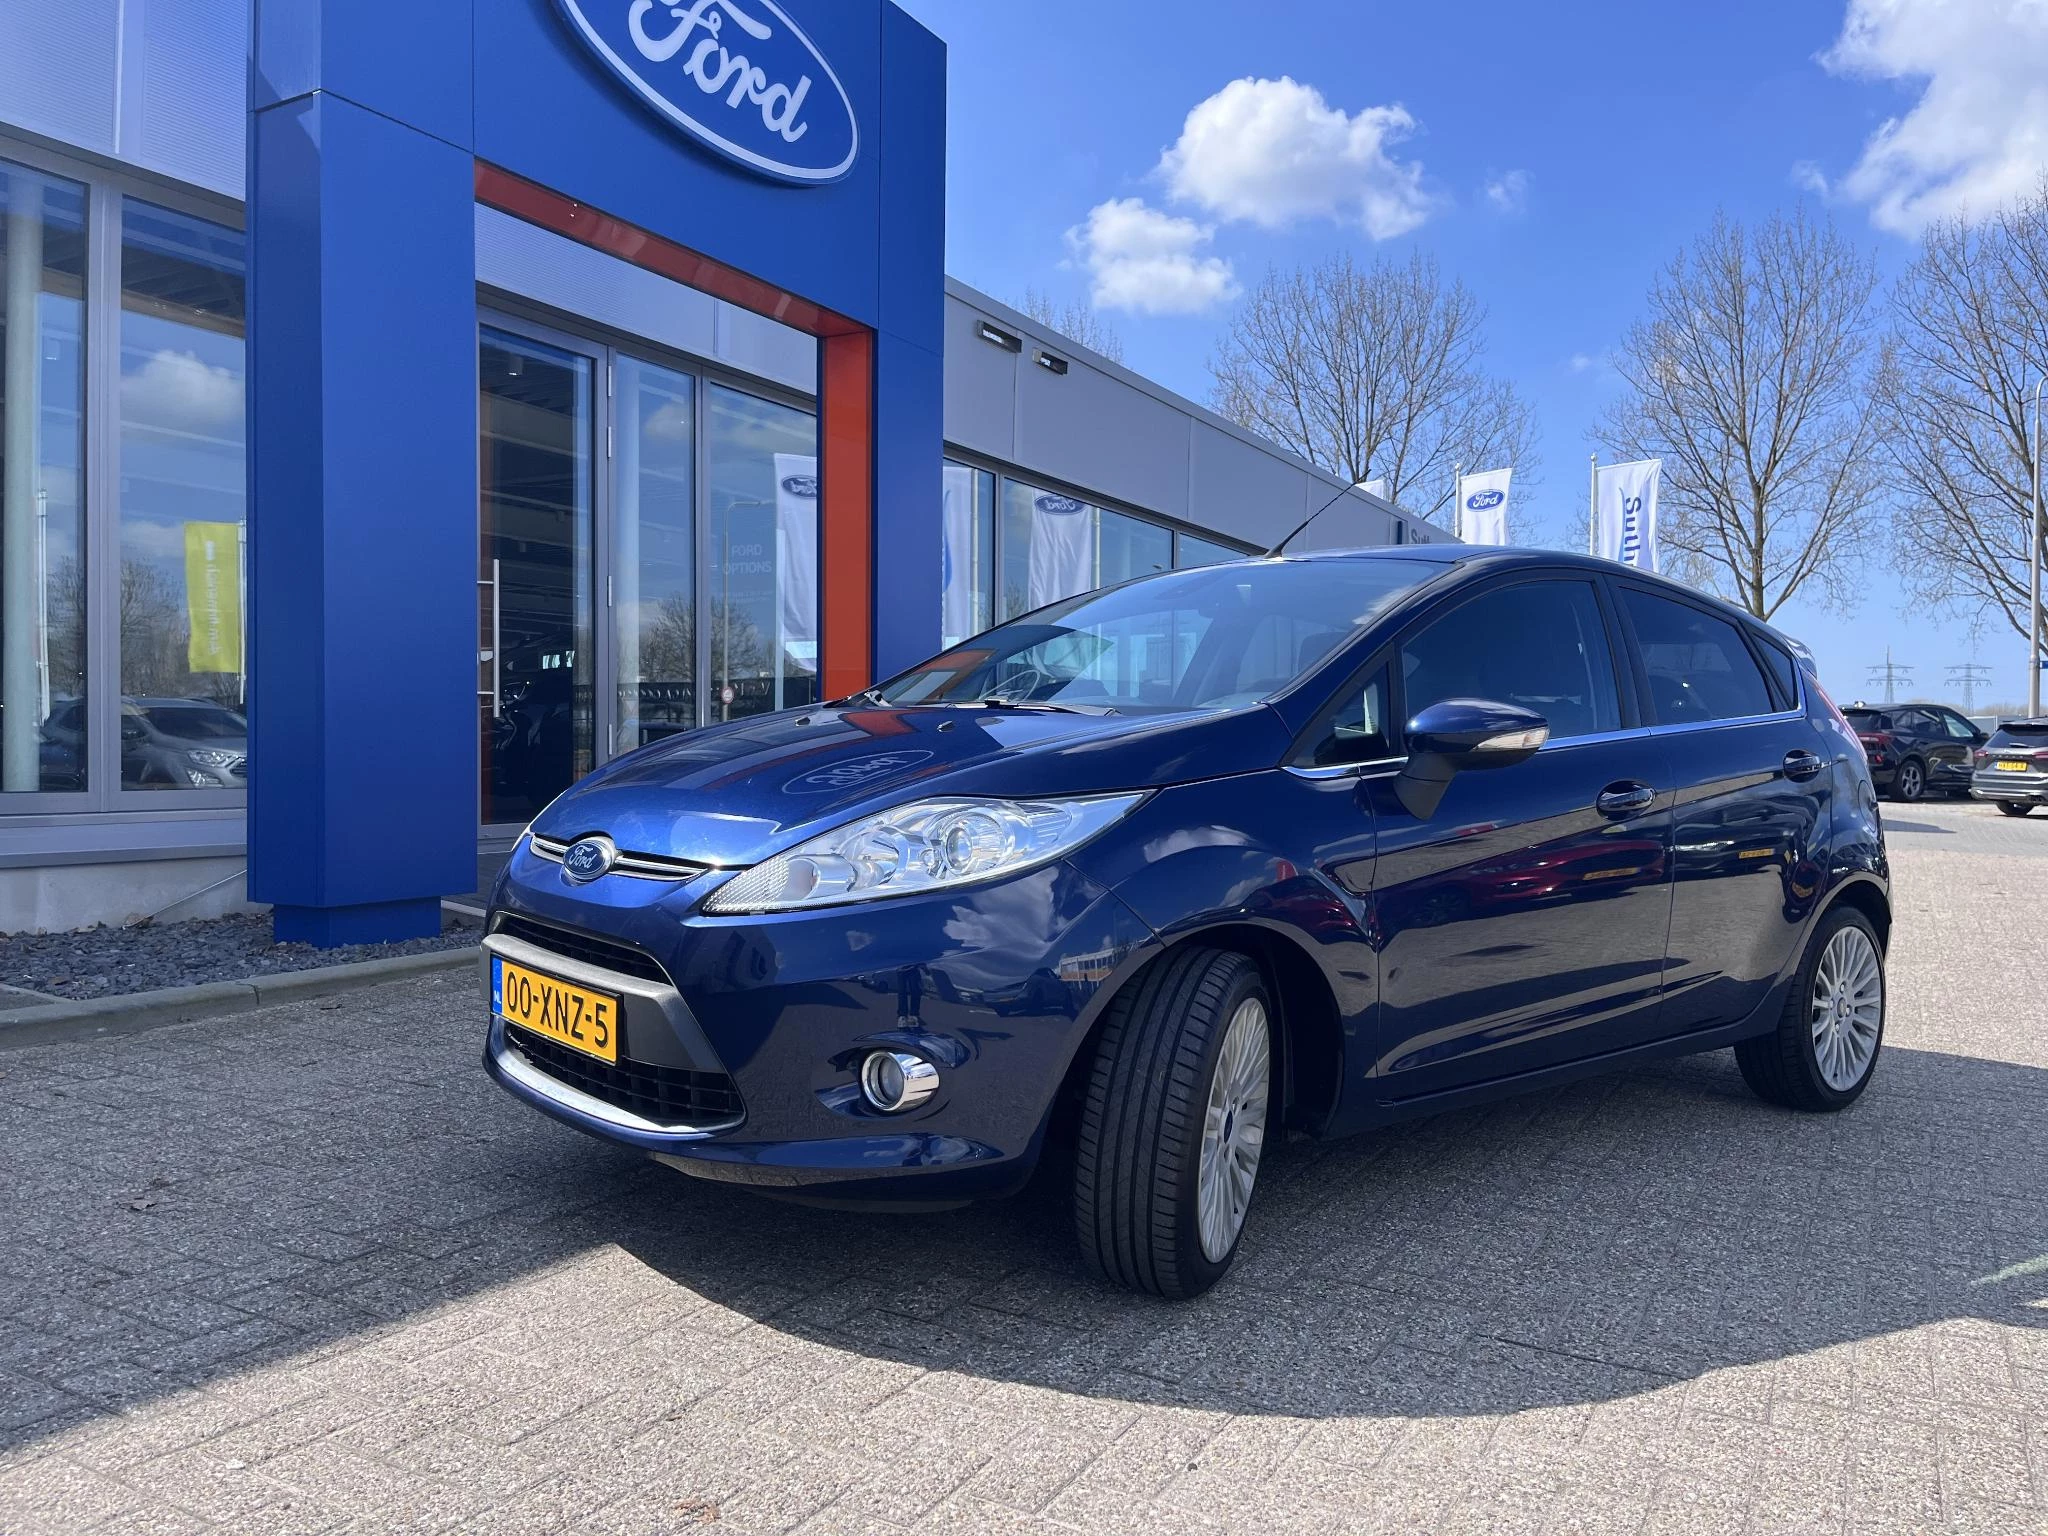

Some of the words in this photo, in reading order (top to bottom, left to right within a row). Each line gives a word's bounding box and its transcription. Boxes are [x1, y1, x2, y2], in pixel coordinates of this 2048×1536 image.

[628, 0, 812, 142] Ford
[1473, 491, 1499, 508] Ford
[731, 544, 763, 557] FORD
[1624, 497, 1641, 566] Suth
[568, 845, 598, 869] Ford
[507, 972, 609, 1048] 00-XNZ-5
